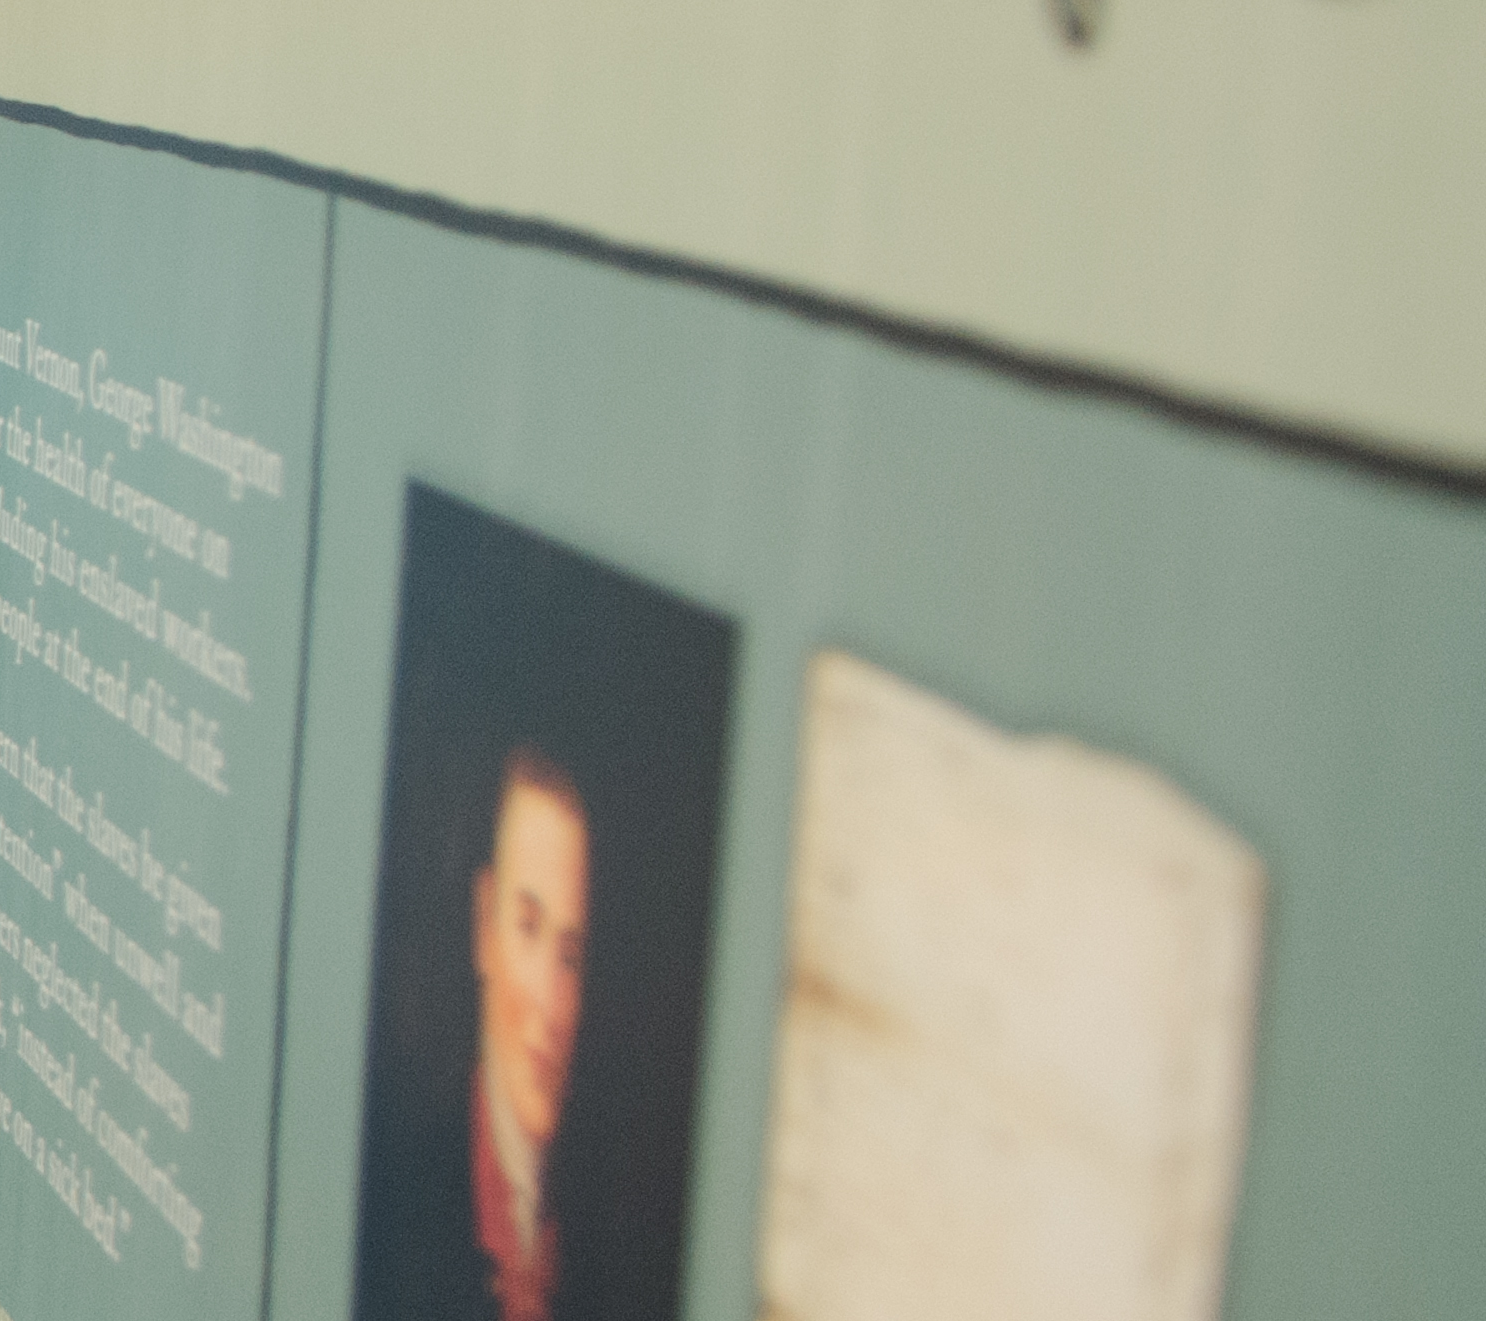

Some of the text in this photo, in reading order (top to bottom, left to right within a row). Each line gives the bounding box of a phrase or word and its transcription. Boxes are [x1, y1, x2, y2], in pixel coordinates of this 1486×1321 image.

[25, 316, 85, 414] Vernon,
[89, 348, 154, 451] George
[156, 376, 285, 502] Washington
[6, 404, 32, 466] the
[34, 415, 87, 498] health
[90, 451, 116, 511] of
[112, 479, 197, 562] everyone
[50, 518, 76, 587] his
[79, 553, 158, 641] enslaved
[43, 630, 60, 673] at
[63, 628, 92, 694] the
[94, 659, 129, 720] end
[22, 735, 56, 809] that
[57, 765, 85, 834] the
[86, 790, 139, 879] slaves
[22, 936, 99, 1041] neglected
[100, 998, 131, 1073] the
[63, 873, 111, 956] when
[113, 927, 180, 1022] unwell
[181, 990, 226, 1061] and
[13, 1110, 33, 1161] on
[47, 1138, 81, 1218] sick
